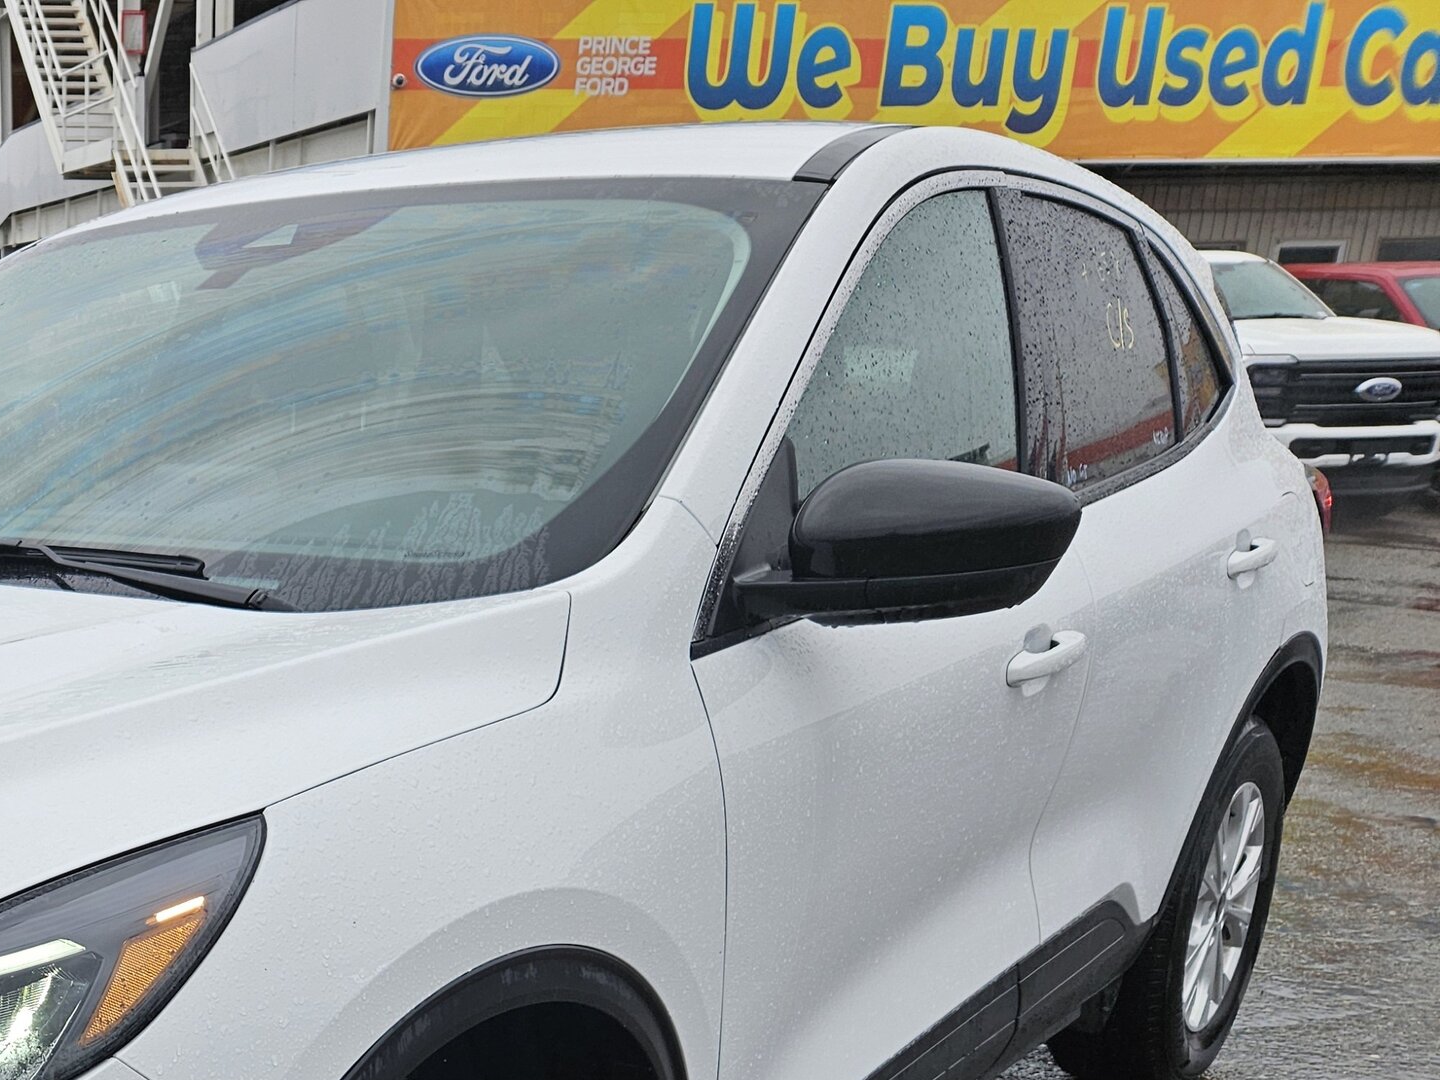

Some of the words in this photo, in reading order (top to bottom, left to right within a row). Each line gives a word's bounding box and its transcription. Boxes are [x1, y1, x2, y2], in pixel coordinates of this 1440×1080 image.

[577, 35, 652, 55] PRINCE
[443, 43, 533, 87] Ford
[575, 56, 658, 76] GEORGE
[685, 2, 853, 112] We
[880, 3, 1070, 135] Buy
[1097, 1, 1326, 108] Used
[1344, 6, 1440, 107] Ca
[573, 77, 629, 97] FORD
